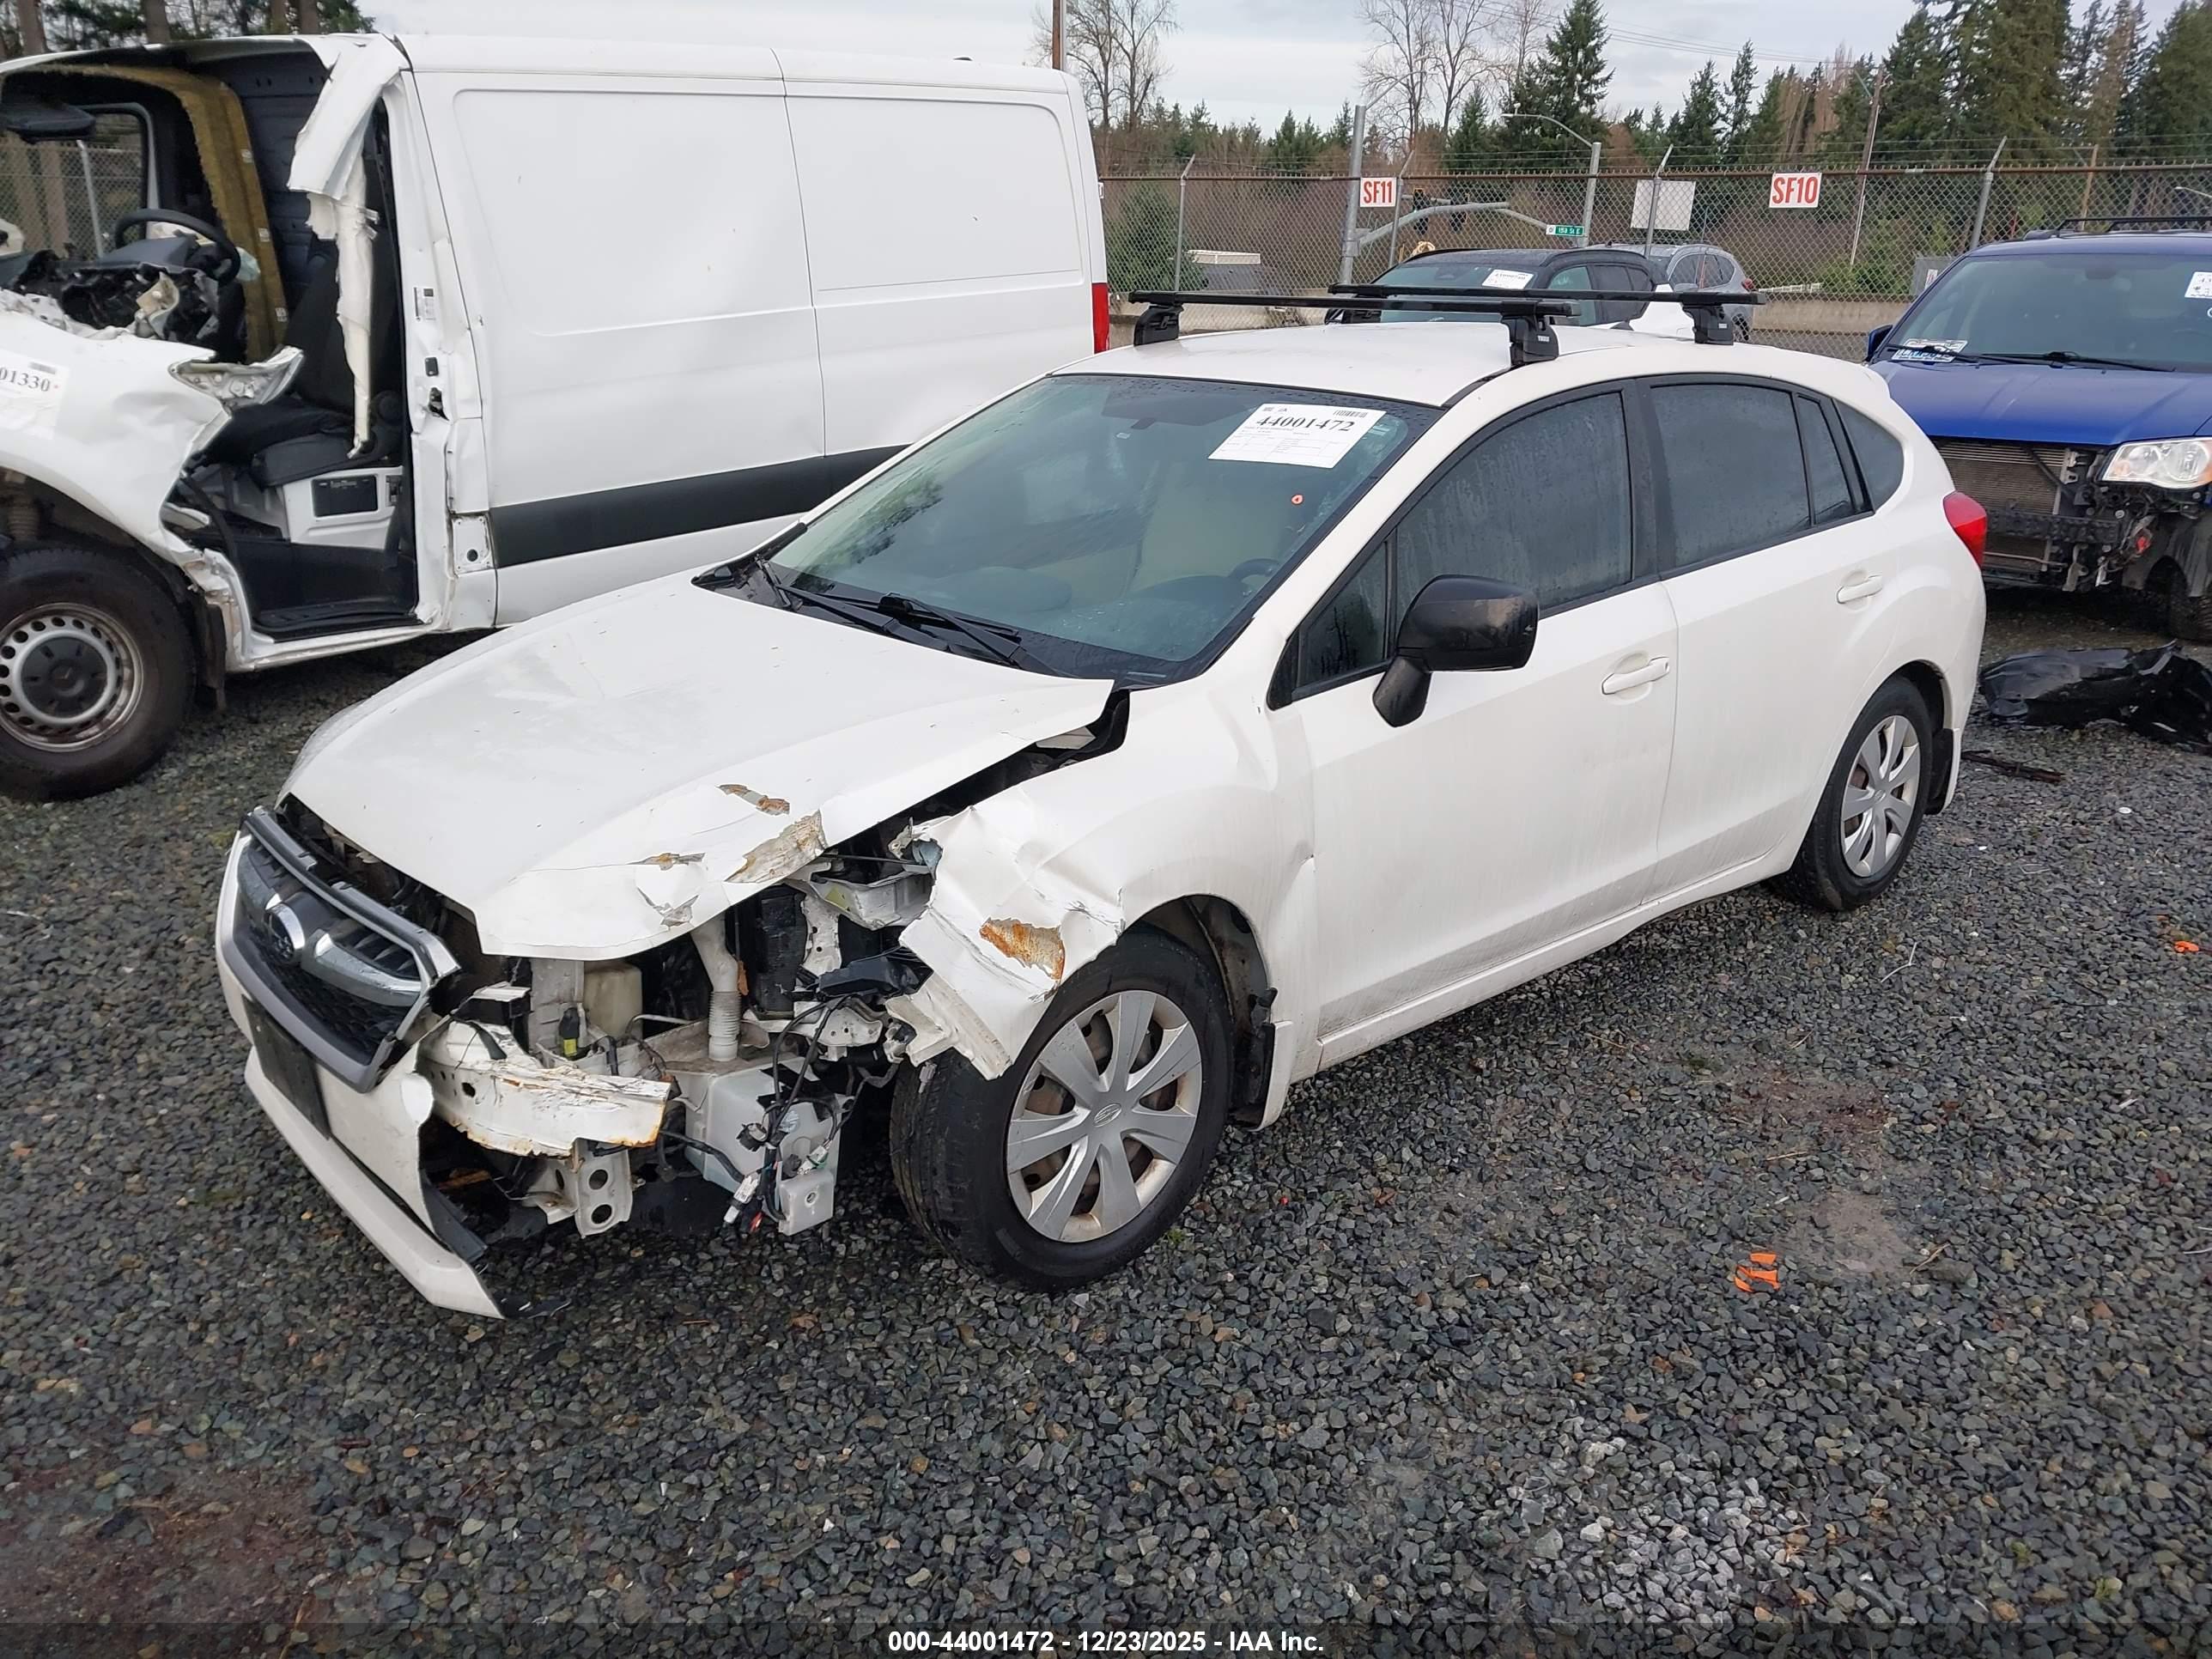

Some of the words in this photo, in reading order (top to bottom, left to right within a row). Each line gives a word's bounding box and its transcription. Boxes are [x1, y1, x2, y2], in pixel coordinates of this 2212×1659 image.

[1363, 180, 1393, 204] SF11
[1771, 176, 1819, 204] SF10
[1256, 416, 1355, 431] 44001472
